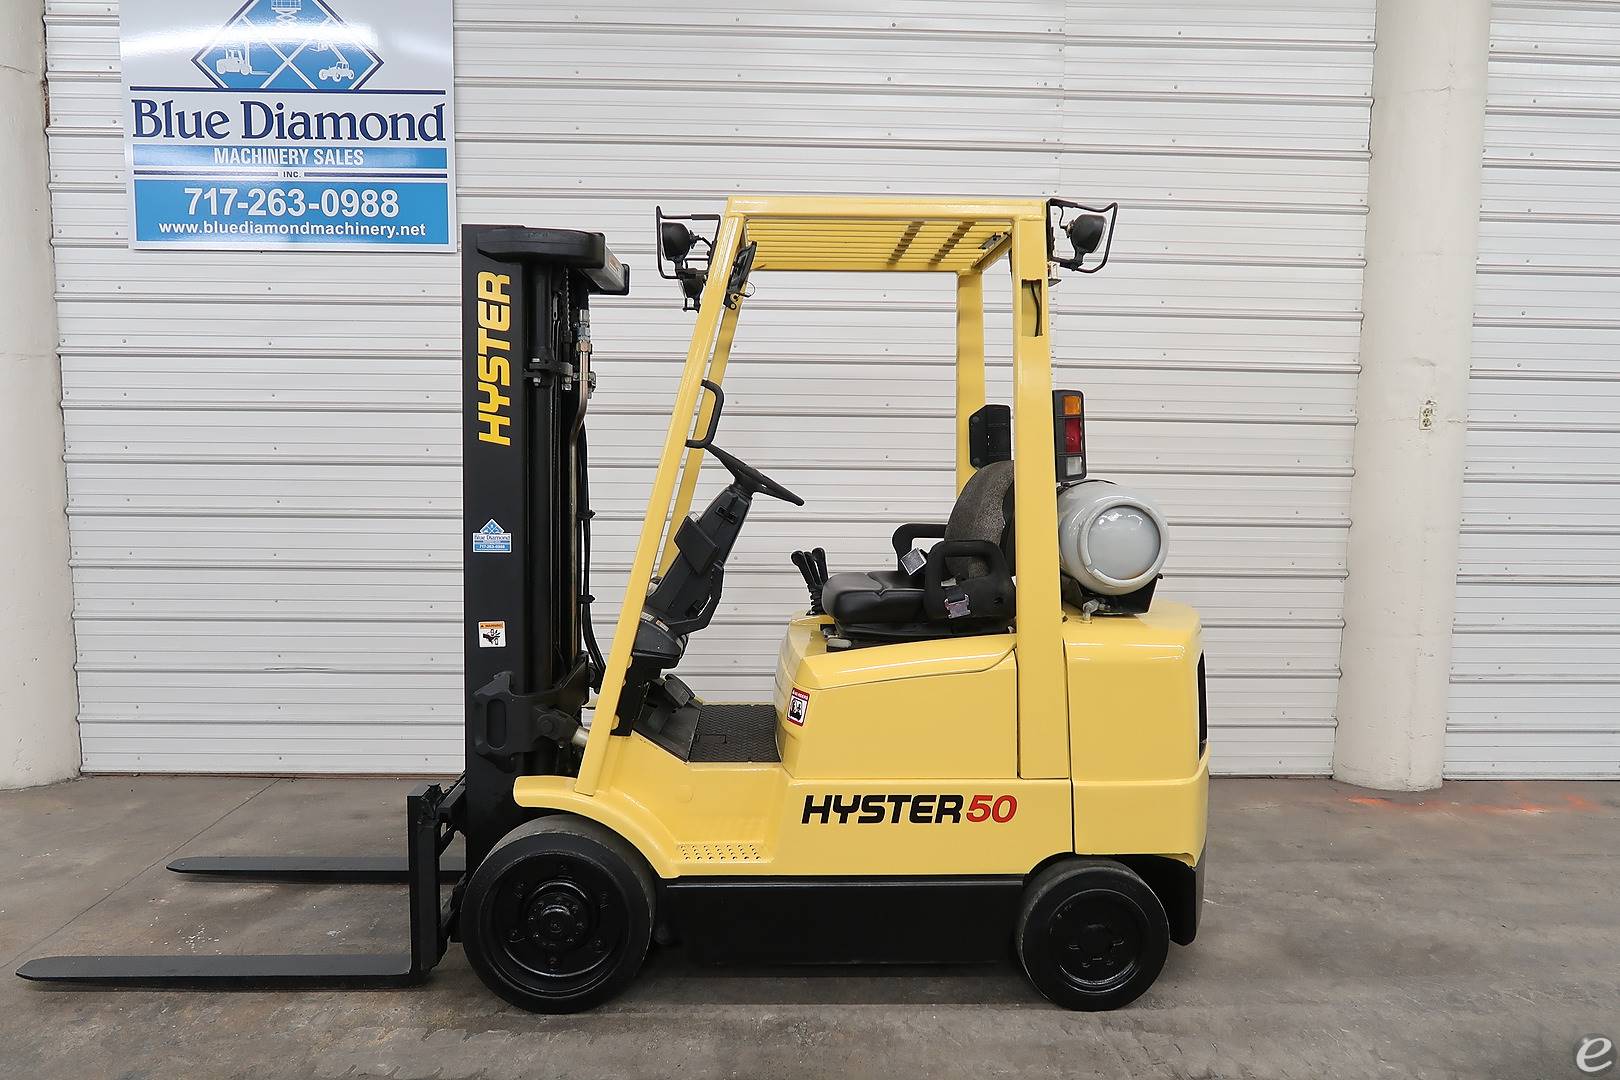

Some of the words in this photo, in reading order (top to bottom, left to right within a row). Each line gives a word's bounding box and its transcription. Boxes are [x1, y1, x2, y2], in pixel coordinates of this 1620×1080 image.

[131, 98, 230, 140] Blue
[240, 100, 446, 142] Diamond
[213, 147, 309, 165] MACHINERY
[313, 148, 364, 166] SALES
[282, 170, 302, 178] INC.
[183, 187, 400, 218] 717-263-0988
[158, 220, 426, 239] www.bluediamondmachinery.net
[477, 271, 511, 446] HYSTER
[801, 794, 964, 824] HYSTER
[966, 794, 1018, 823] 50
